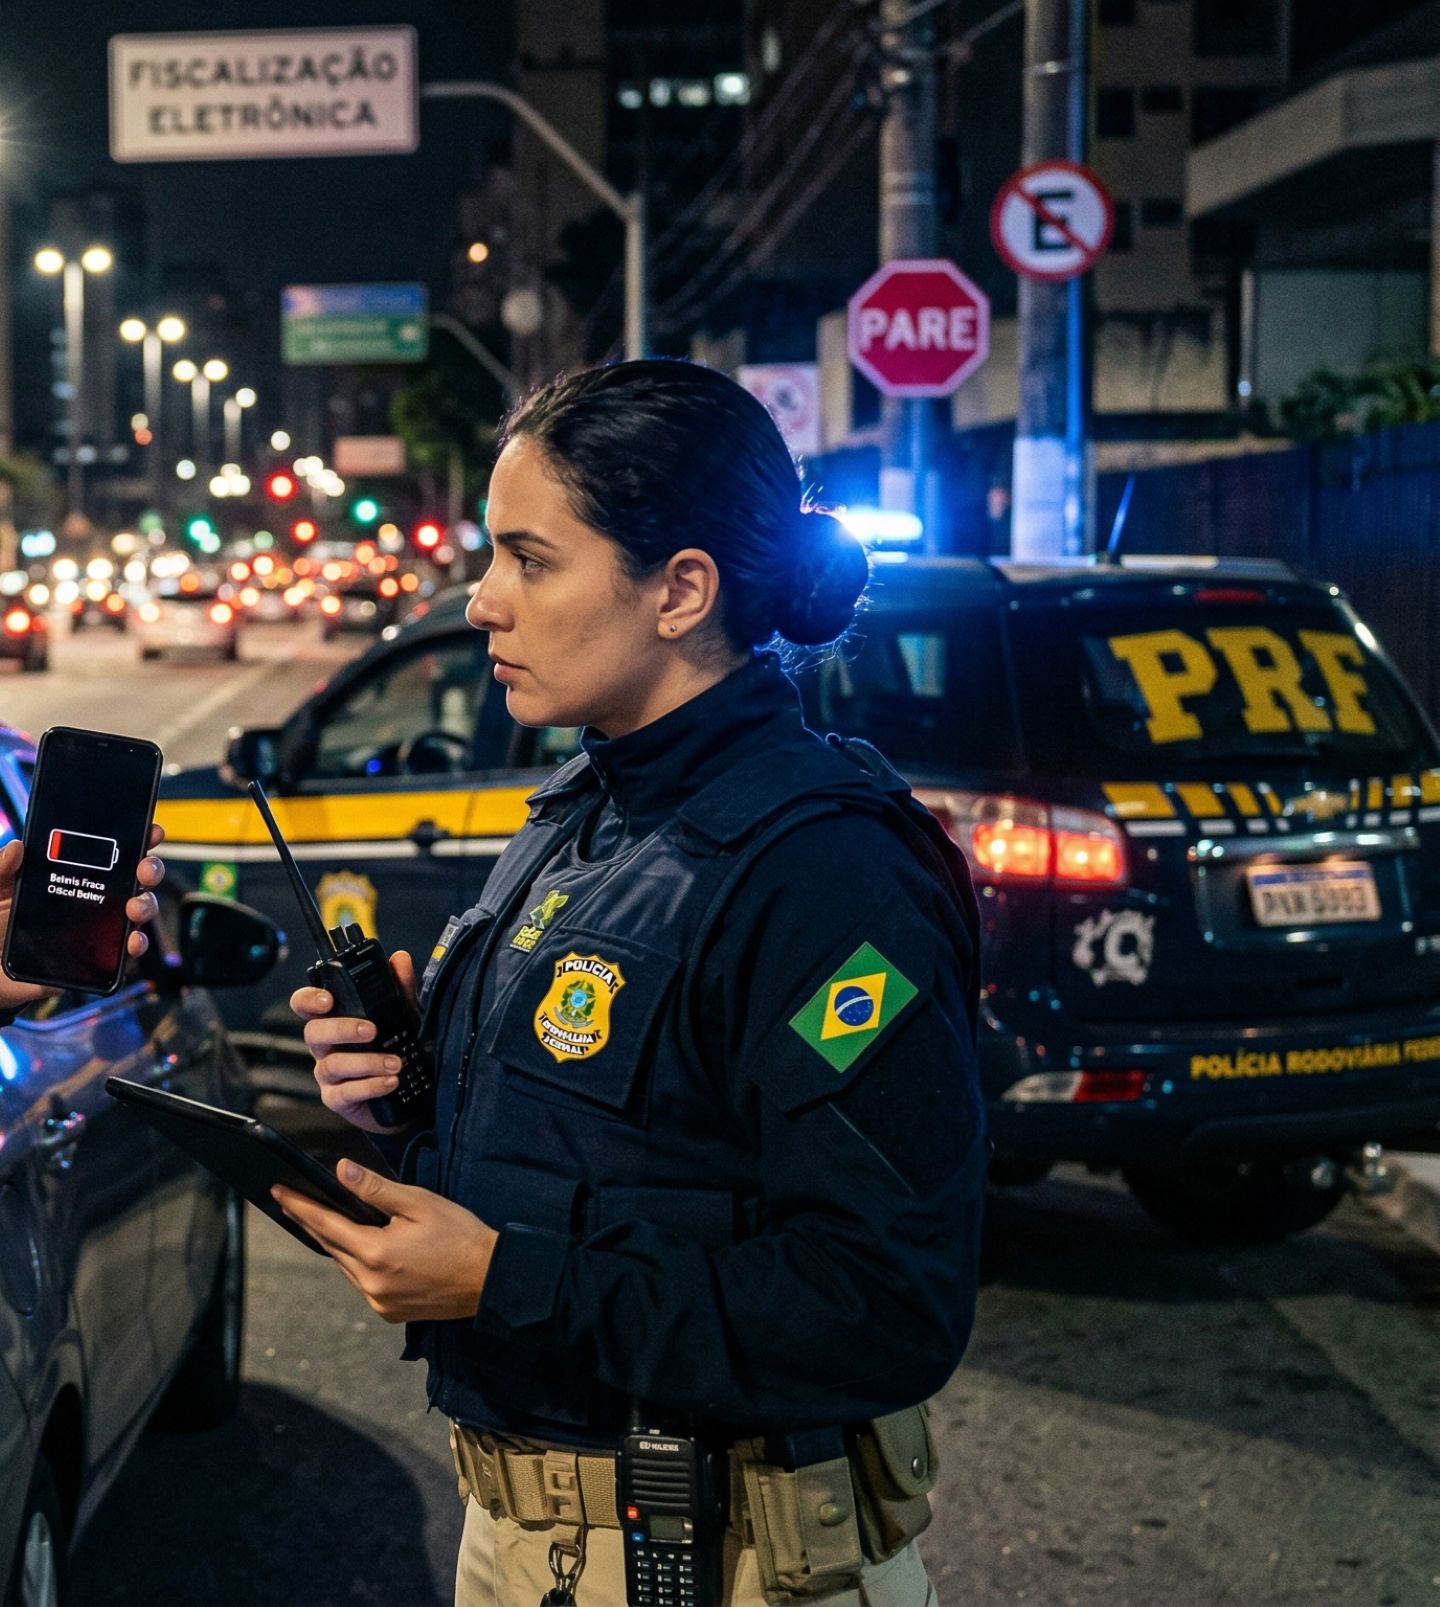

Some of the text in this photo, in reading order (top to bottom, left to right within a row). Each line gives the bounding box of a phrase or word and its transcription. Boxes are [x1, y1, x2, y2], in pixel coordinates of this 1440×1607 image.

[129, 47, 398, 88] FISCALIZAÇÃO
[148, 94, 377, 134] ELETRÔNICA
[860, 306, 976, 351] PARE
[1108, 626, 1376, 744] PRF
[1190, 1047, 1282, 1080] POLÍCIA
